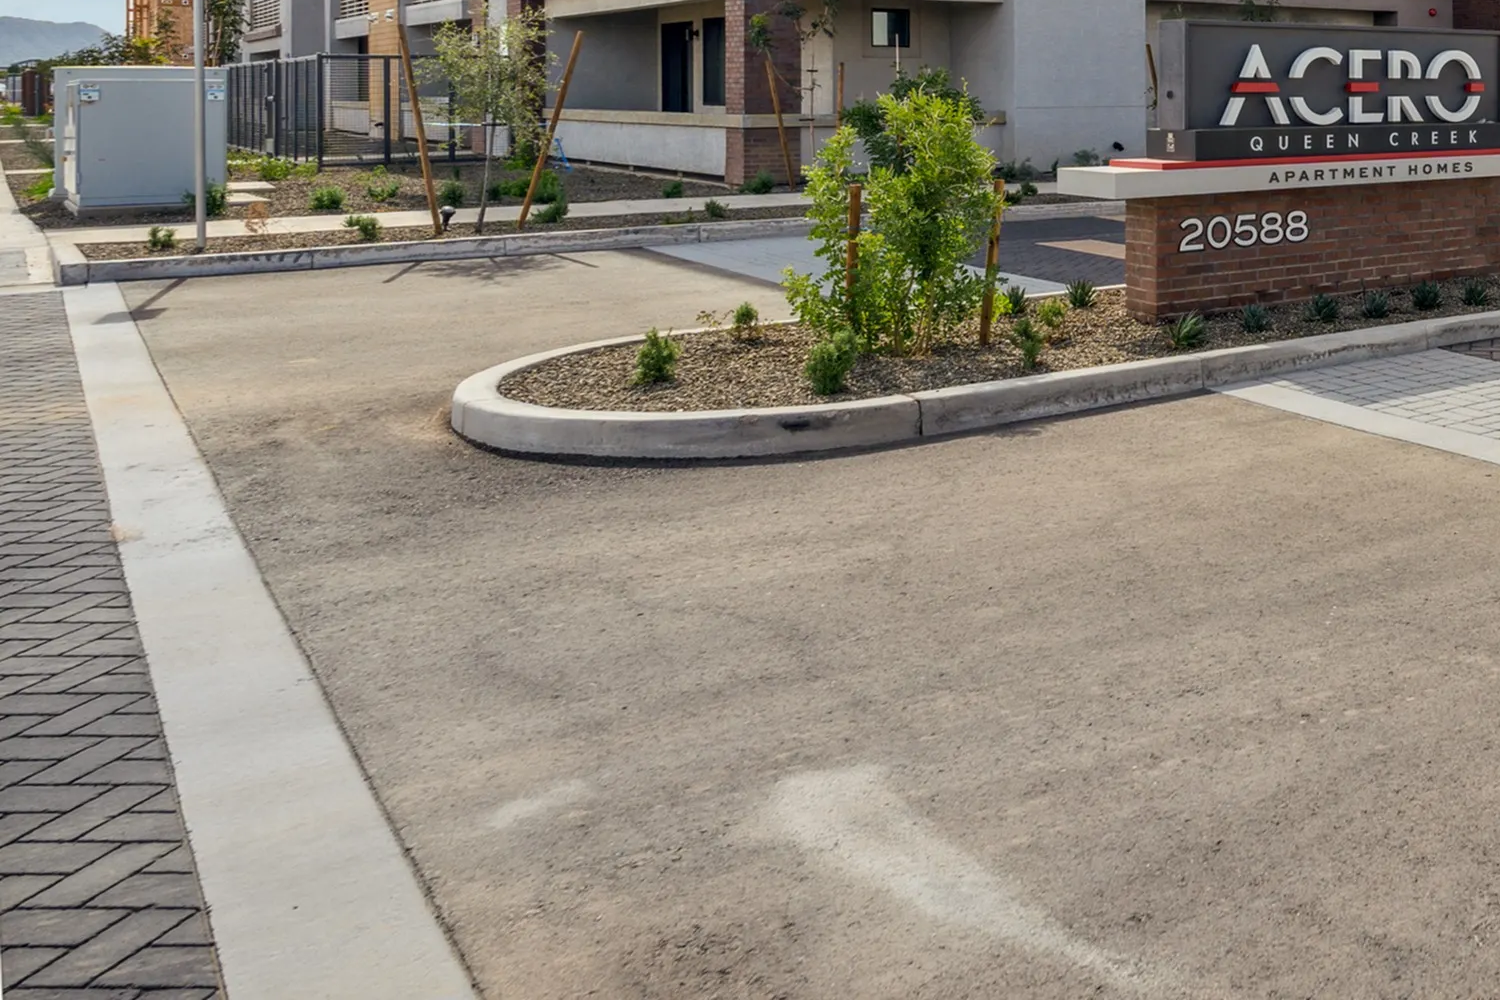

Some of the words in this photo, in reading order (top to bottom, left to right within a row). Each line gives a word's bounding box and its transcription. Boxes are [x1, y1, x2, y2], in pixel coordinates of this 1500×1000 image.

[1219, 44, 1485, 126] ACERO
[1250, 133, 1359, 152] QUEEN
[1389, 130, 1478, 147] CREEK
[1268, 166, 1396, 184] APARTMENT
[1408, 161, 1474, 176] HOMES
[1178, 209, 1310, 253] 20588
